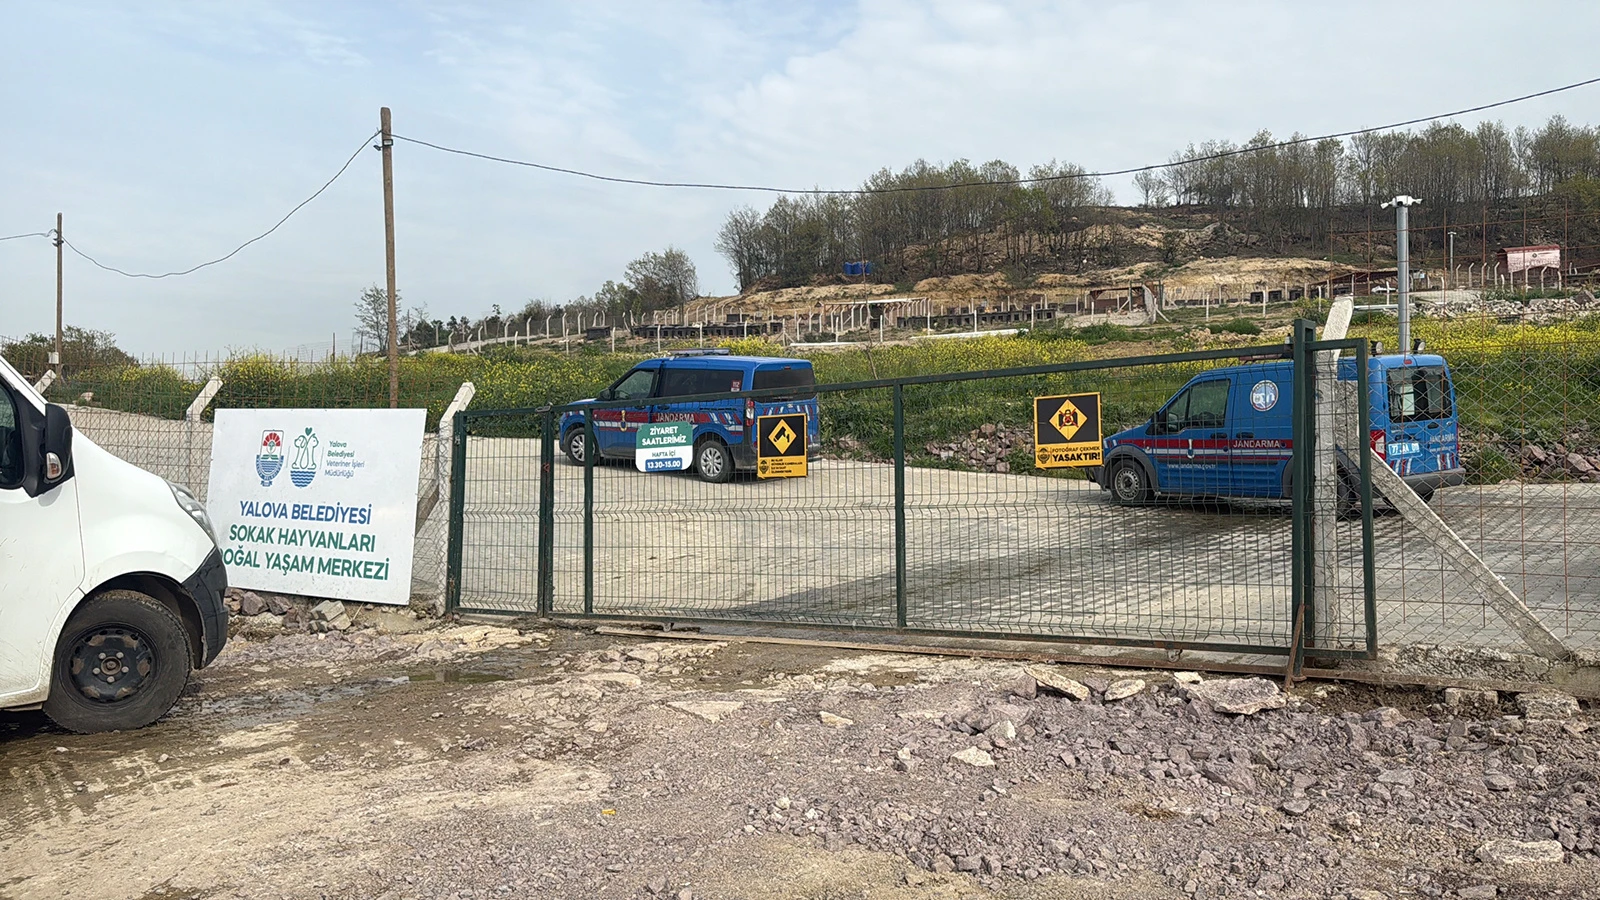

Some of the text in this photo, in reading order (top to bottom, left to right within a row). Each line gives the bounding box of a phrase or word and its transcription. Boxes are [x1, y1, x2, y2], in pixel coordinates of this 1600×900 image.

[656, 413, 695, 423] JANDARMA
[650, 426, 679, 436] ZİYARET
[642, 434, 687, 446] SAATLERİMİZ
[1233, 440, 1280, 448] JANDARMA
[327, 450, 355, 459] Belediyesi
[1052, 452, 1101, 462] YASAKTIR!
[647, 460, 681, 468] 13.30-15.00
[240, 501, 372, 525] YALOVA BELEDİYESİ
[229, 524, 376, 552] SOKAK HAYVANLARI
[221, 545, 390, 580] OĞAL YAŞAM MERKEZİ
